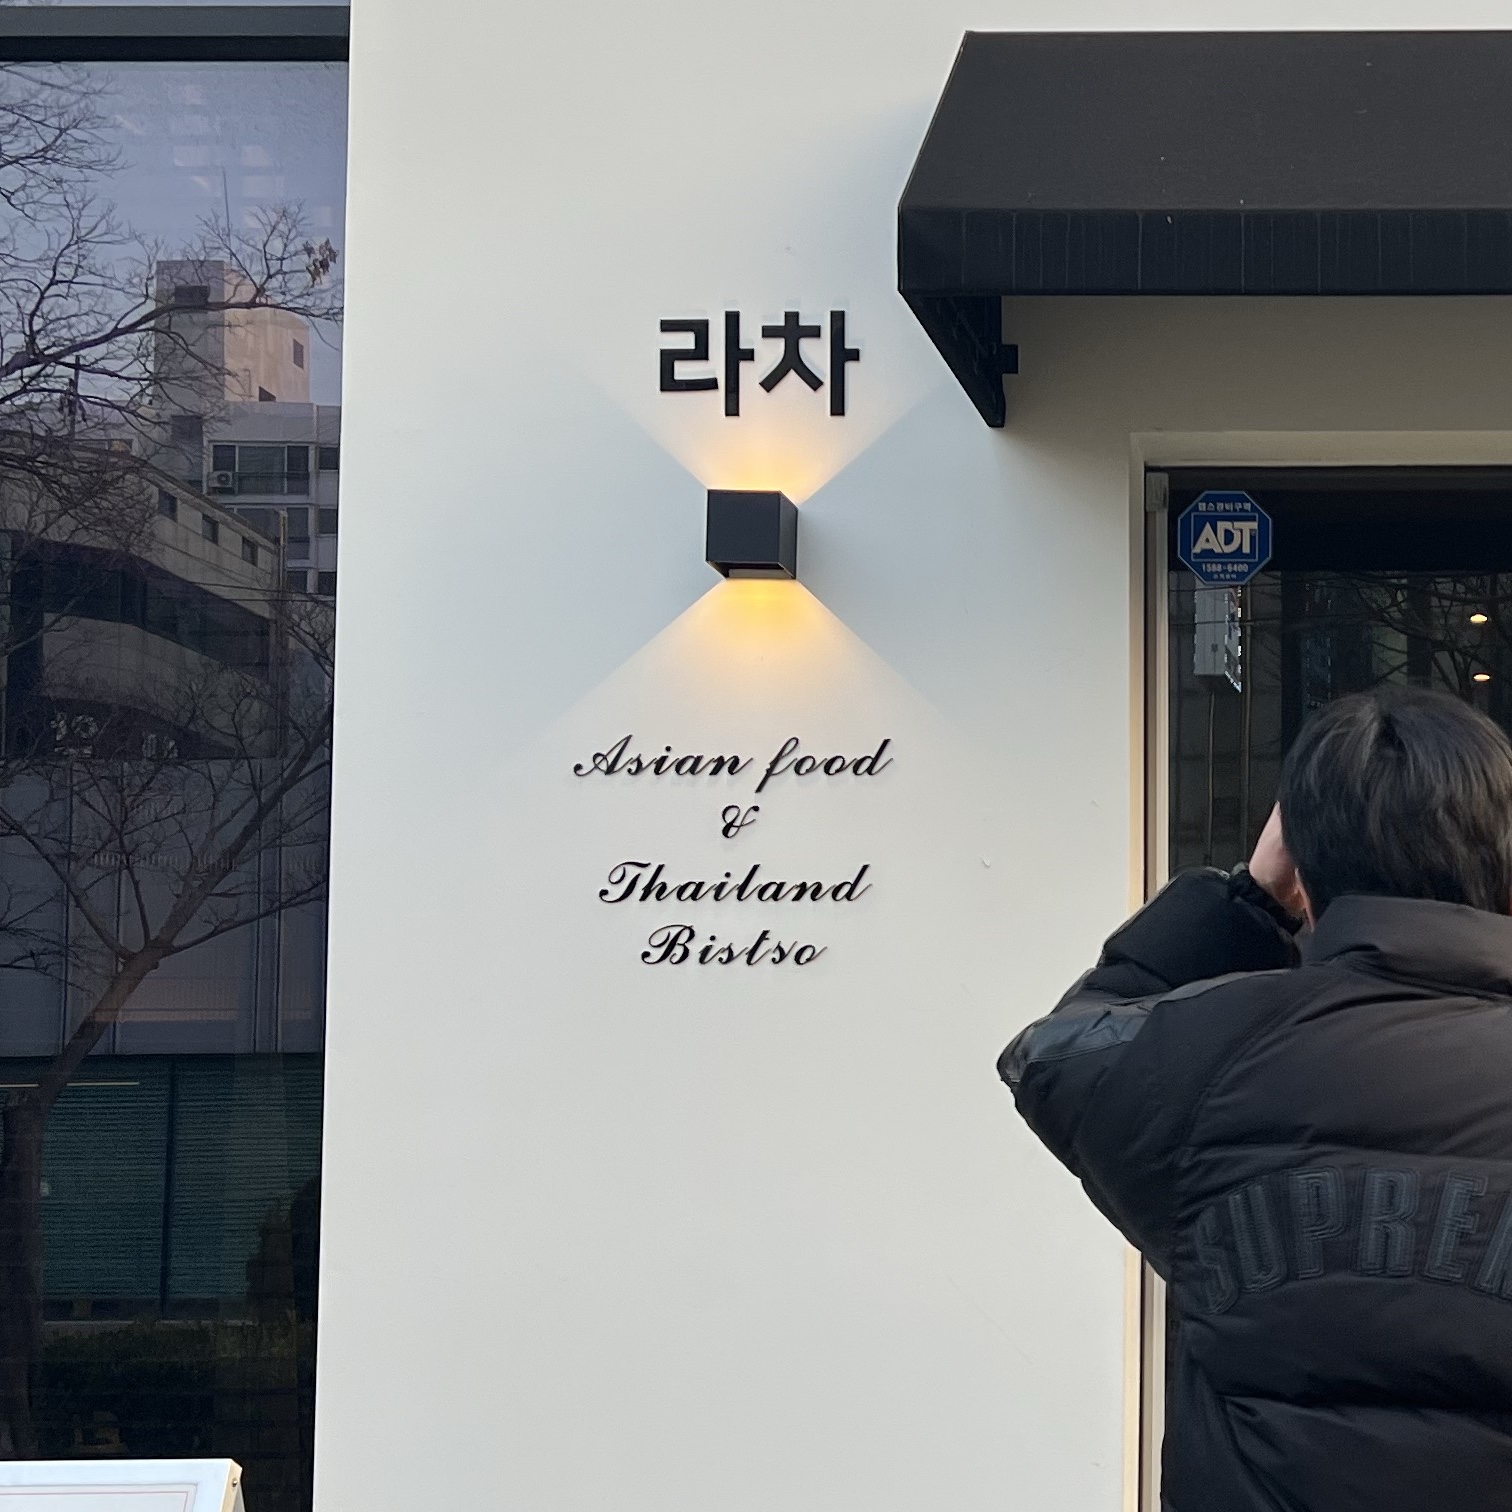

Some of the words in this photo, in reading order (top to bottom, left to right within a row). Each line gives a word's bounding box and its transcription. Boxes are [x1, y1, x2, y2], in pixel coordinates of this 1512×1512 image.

[658, 309, 860, 418] 라차
[1192, 520, 1258, 554] ADT
[1201, 562, 1249, 573] 1588-6400
[571, 732, 754, 779] Asian
[755, 736, 892, 793] food
[720, 803, 760, 840] &
[597, 860, 873, 906] Thailand
